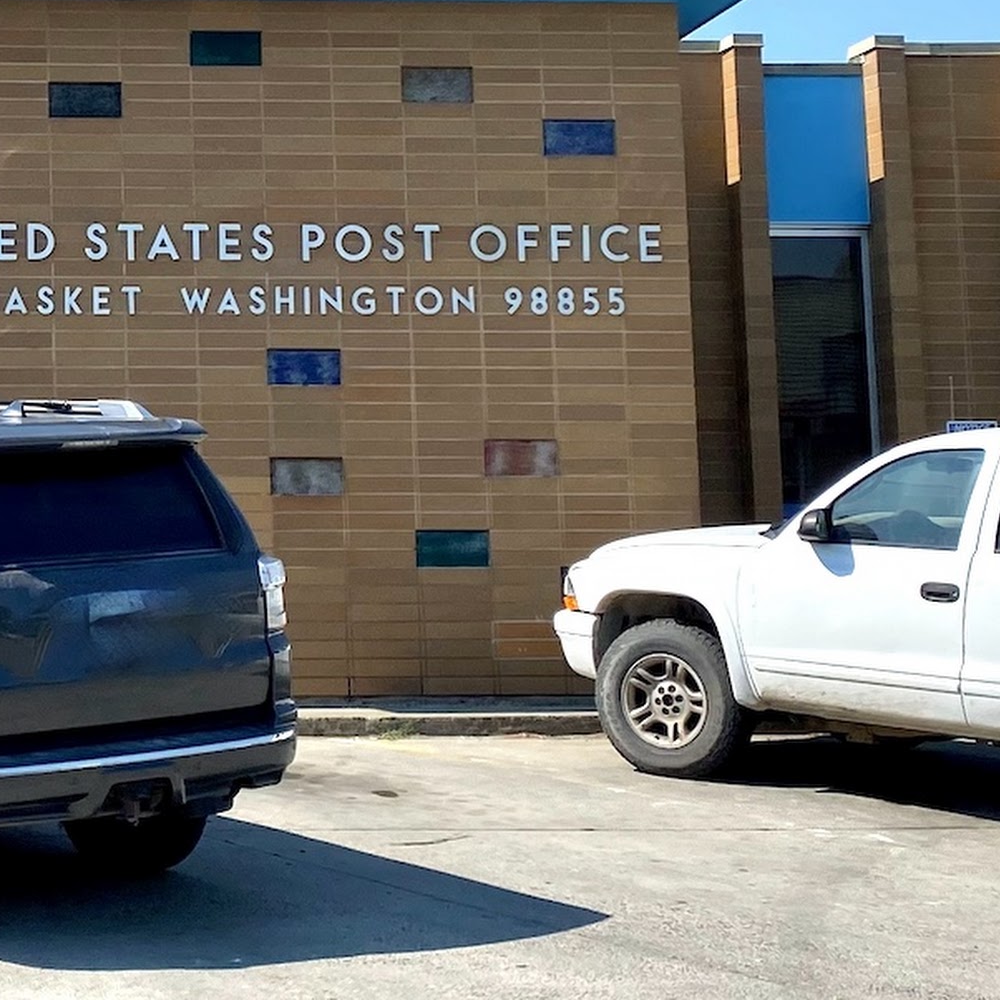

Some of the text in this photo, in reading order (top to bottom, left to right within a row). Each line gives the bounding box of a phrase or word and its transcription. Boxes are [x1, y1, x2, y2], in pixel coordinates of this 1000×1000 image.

[84, 223, 275, 261] STATES
[301, 224, 441, 262] POST
[469, 225, 664, 263] OFFICE
[180, 286, 477, 316] WASHINGTON
[504, 287, 627, 316] 98855
